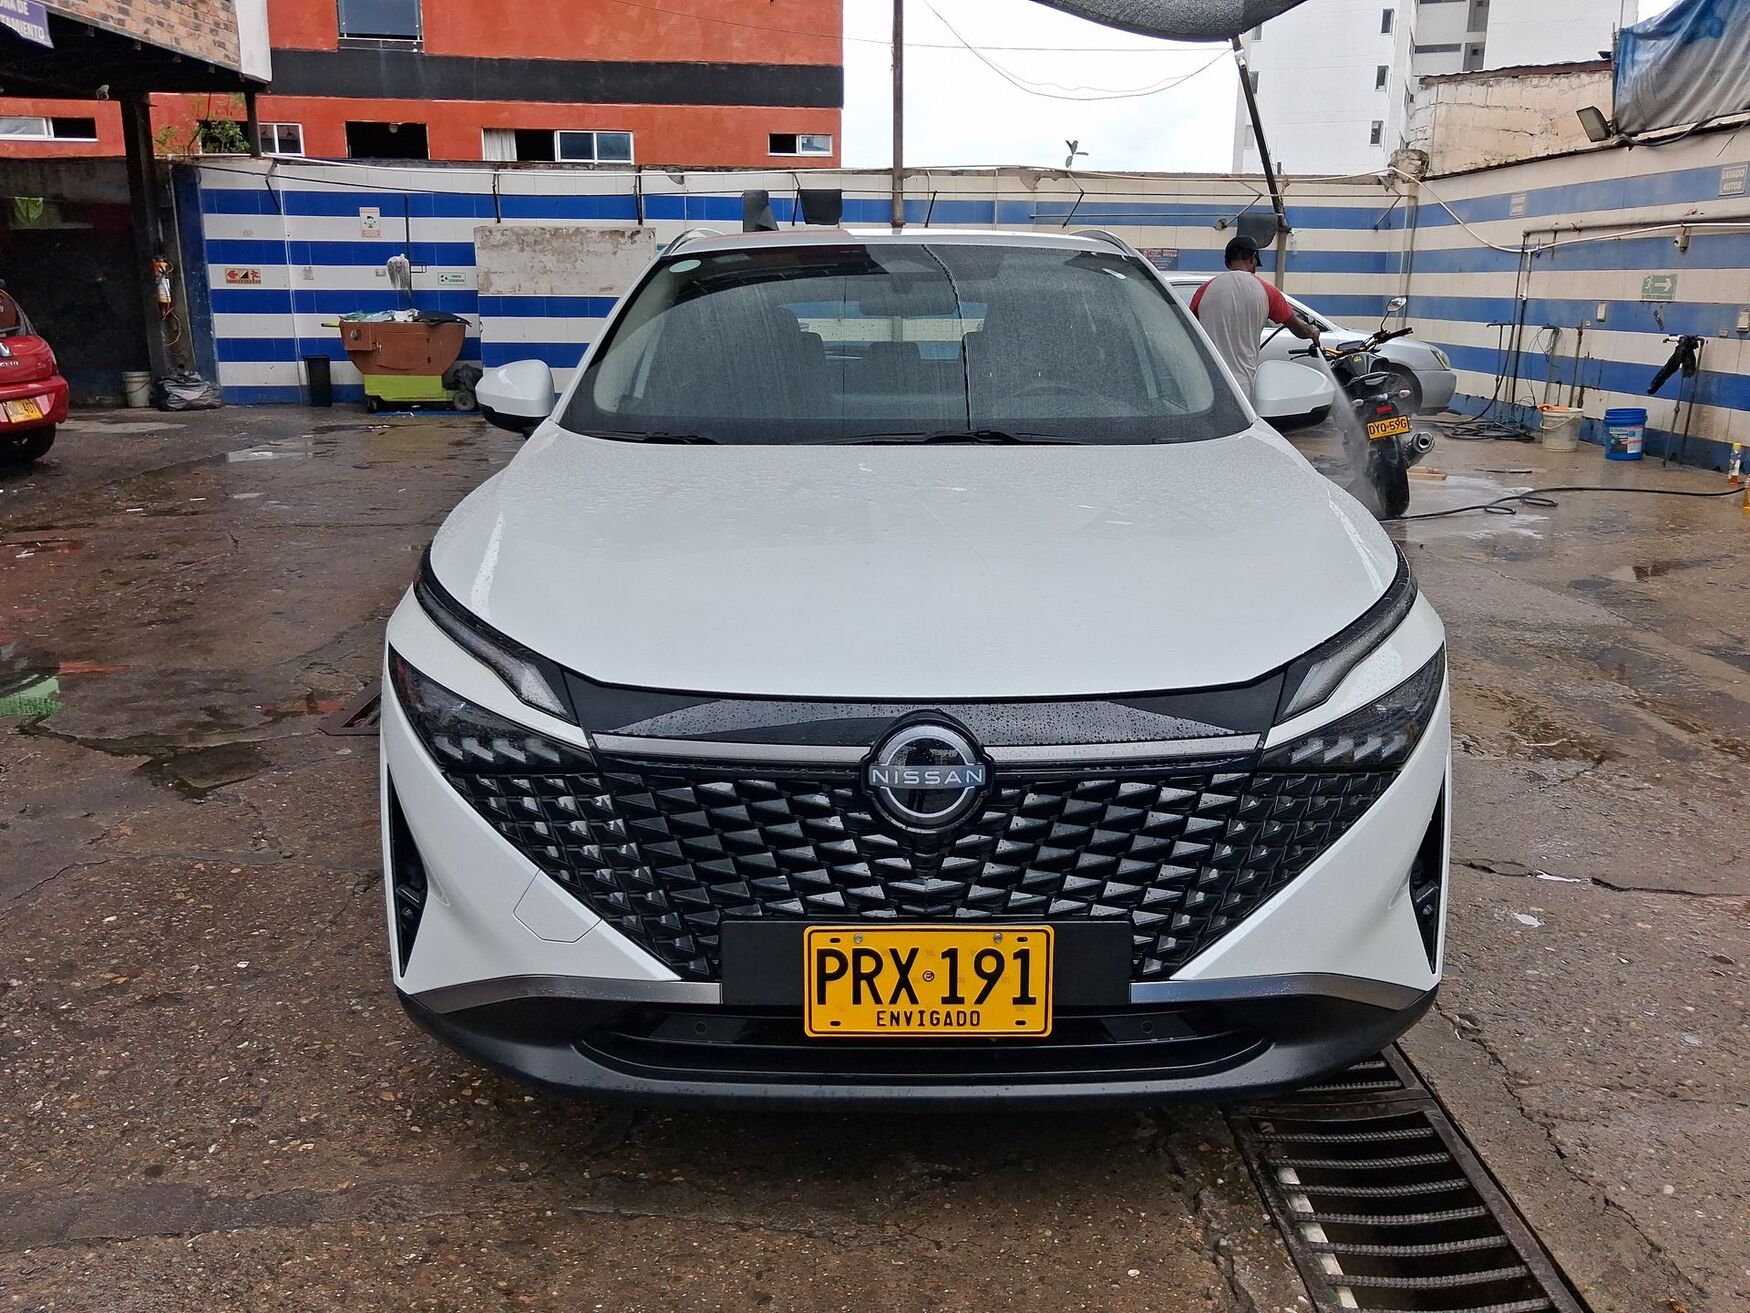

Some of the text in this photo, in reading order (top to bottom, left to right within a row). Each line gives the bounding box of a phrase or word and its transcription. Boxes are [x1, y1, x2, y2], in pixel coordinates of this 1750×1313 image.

[18, 1, 30, 16] DE
[1389, 418, 1407, 431] 59G
[872, 768, 984, 785] NISSAN
[816, 947, 1037, 1005] PRX 191
[877, 1010, 981, 1027] ENVIGADO
